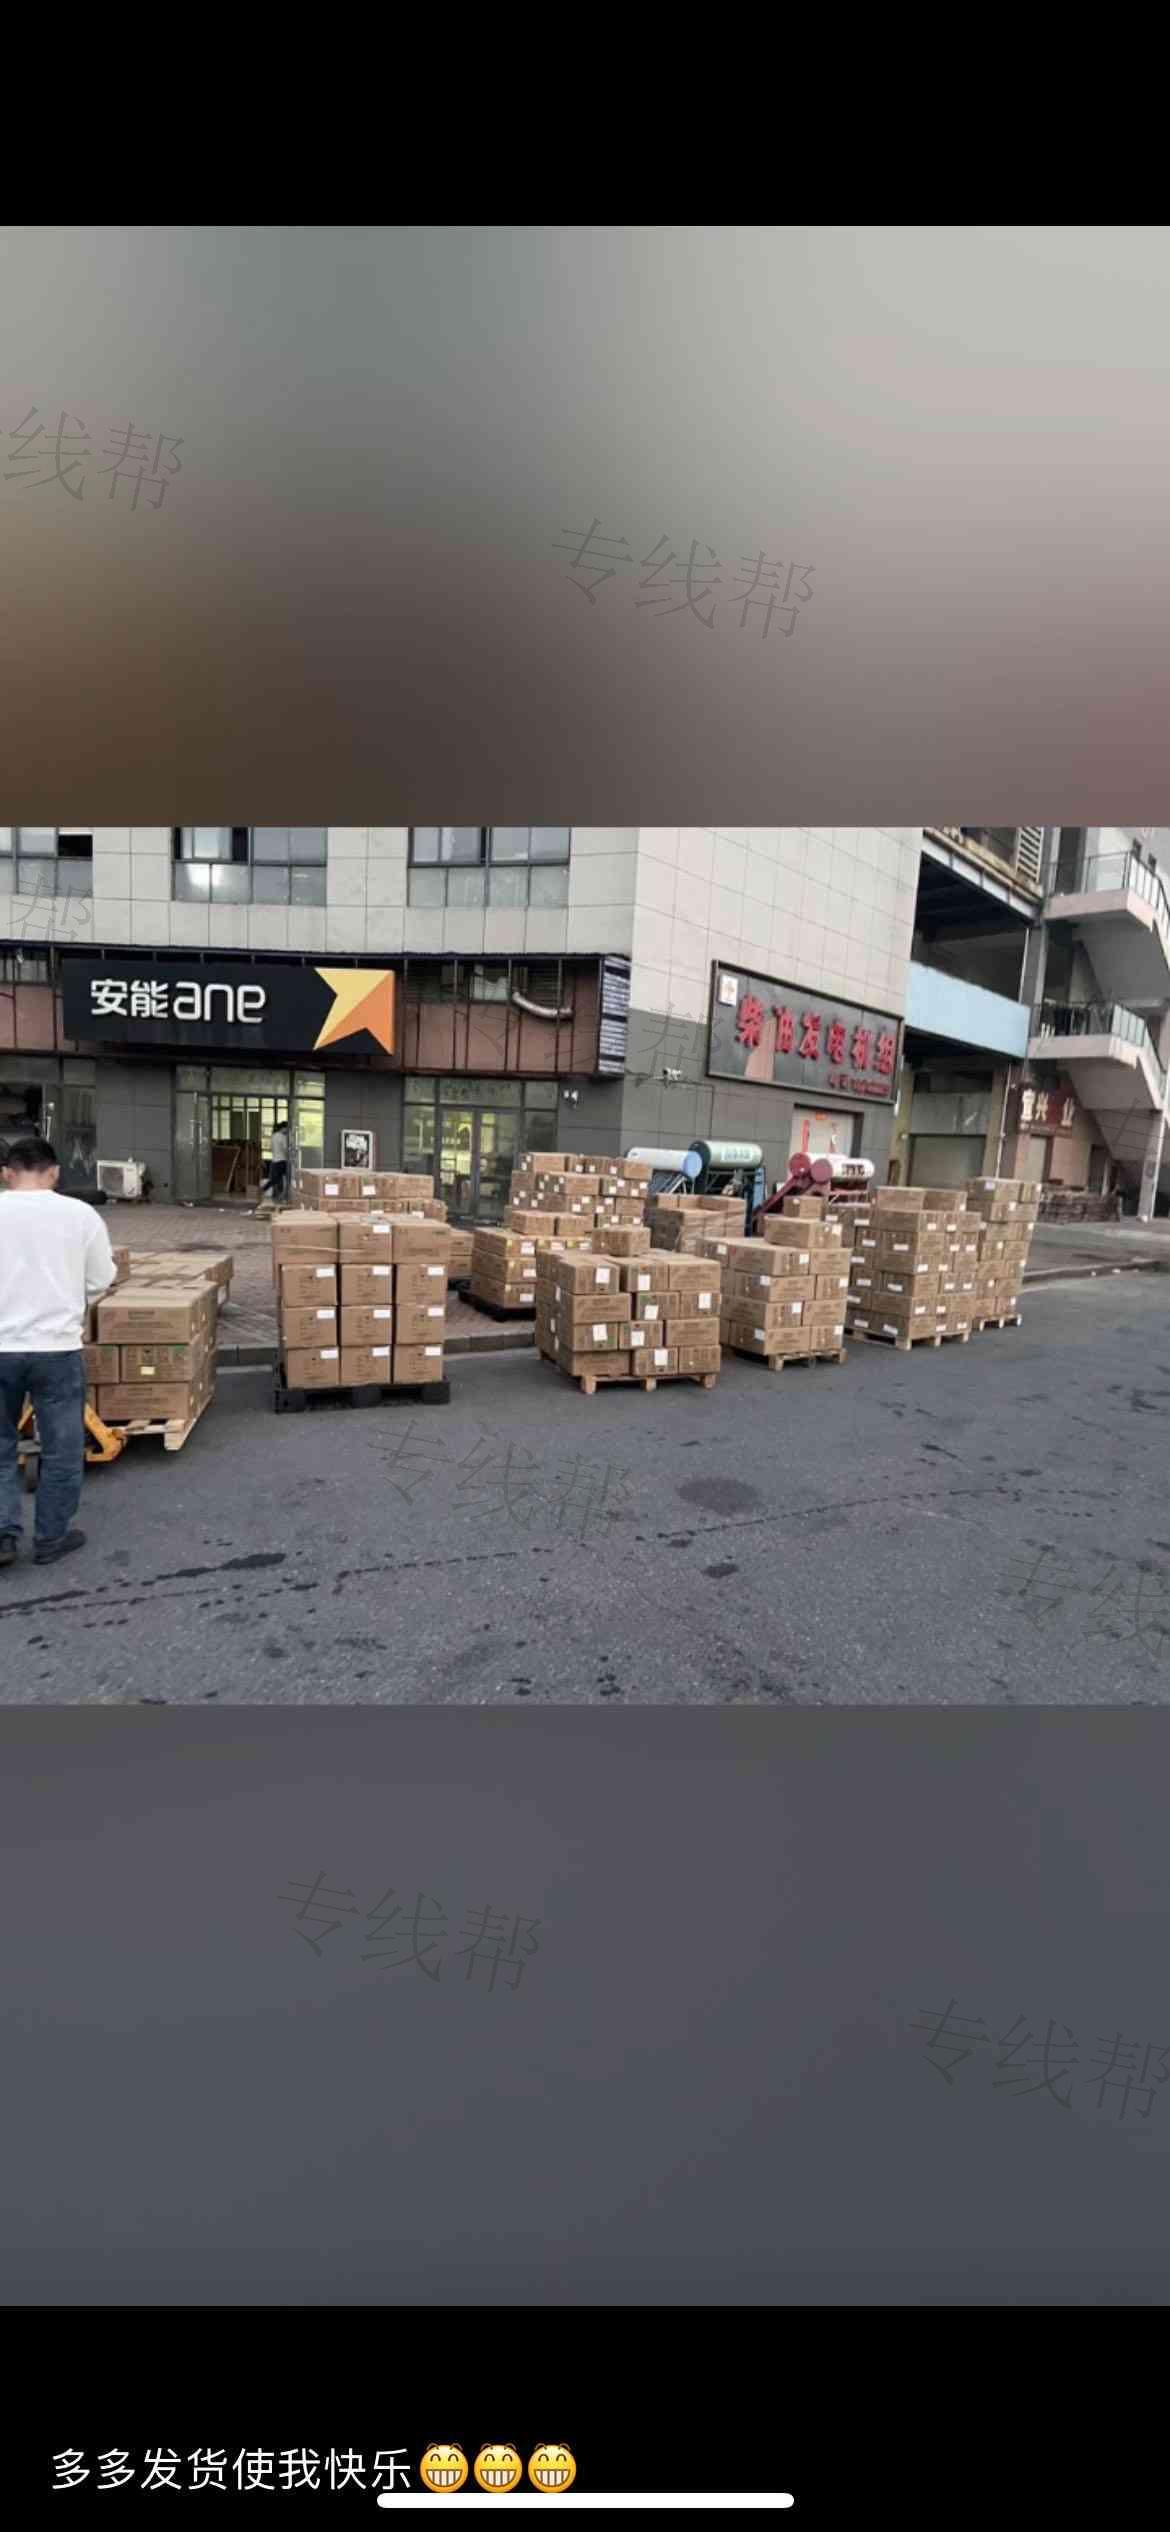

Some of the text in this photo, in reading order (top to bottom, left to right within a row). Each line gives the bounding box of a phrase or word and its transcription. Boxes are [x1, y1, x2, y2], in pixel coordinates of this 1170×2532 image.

[735, 991, 897, 1075] 柴油发电机组
